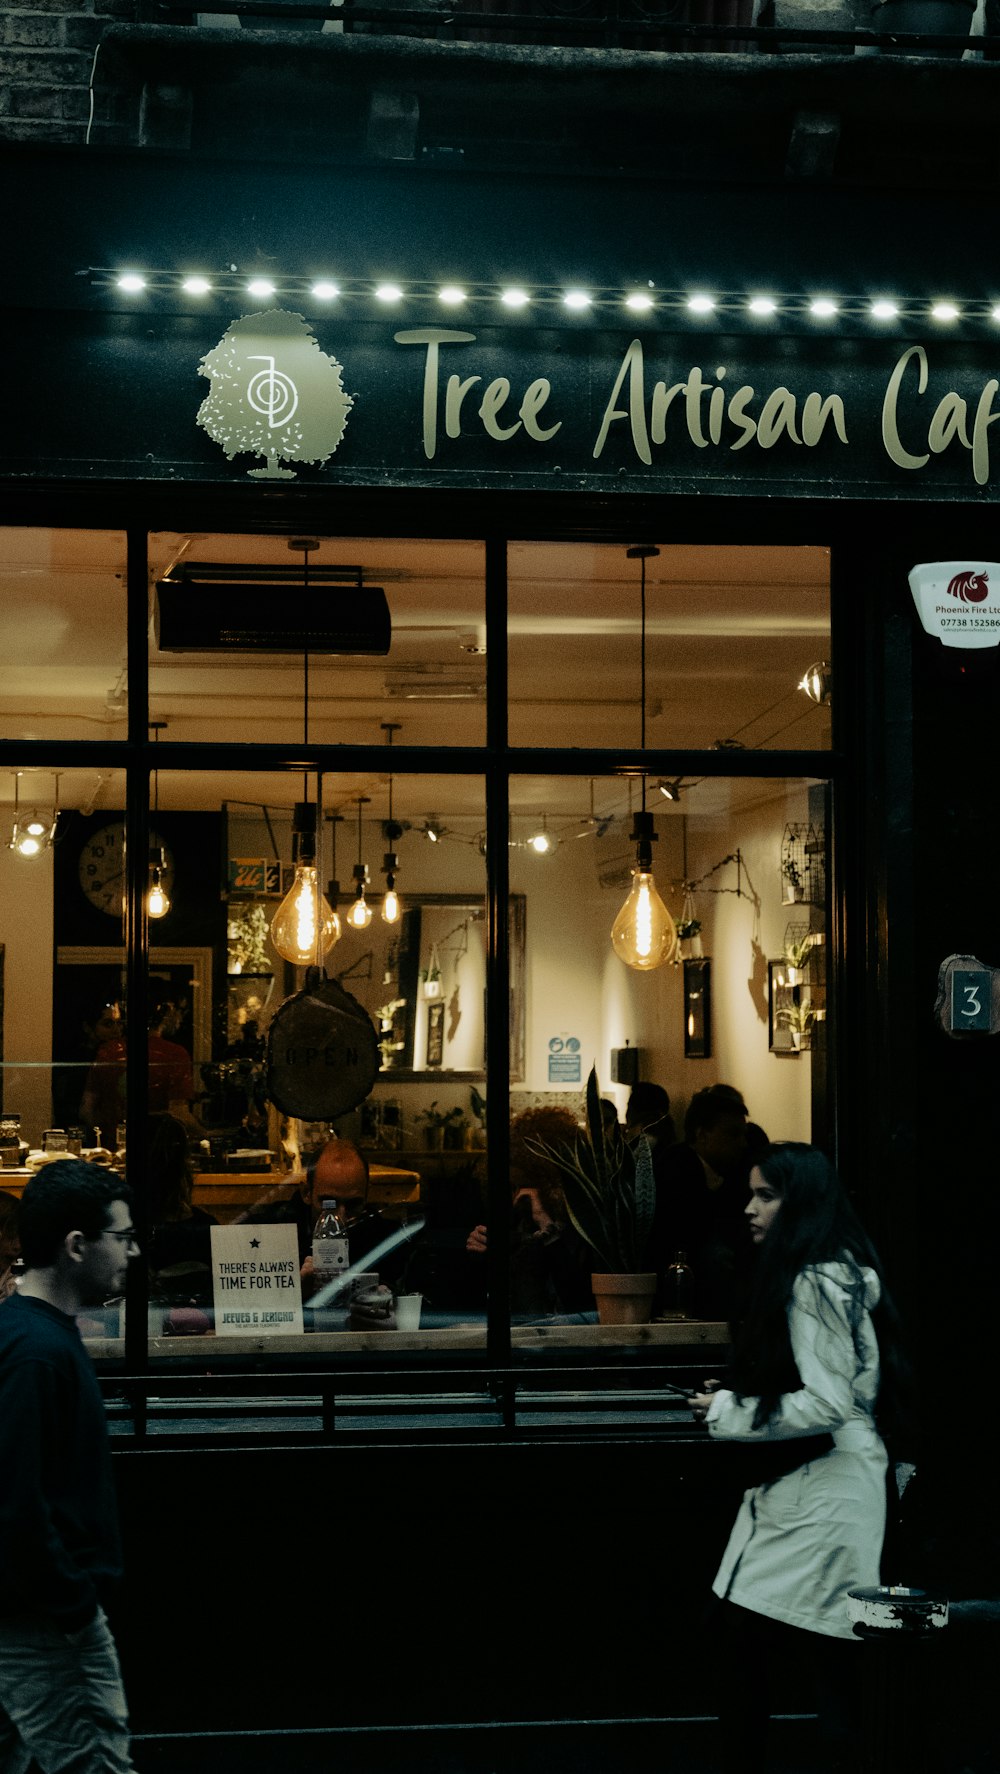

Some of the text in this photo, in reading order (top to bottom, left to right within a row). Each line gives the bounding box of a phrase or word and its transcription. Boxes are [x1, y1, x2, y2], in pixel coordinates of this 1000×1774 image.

[394, 329, 562, 459] Tree
[593, 339, 849, 466] Artisan
[936, 606, 969, 614] Phoenix
[972, 606, 987, 614] Fire
[961, 986, 981, 1016] 3
[287, 1047, 358, 1066] OPEN
[219, 1261, 294, 1274] THERE'S ALWAYS
[220, 1275, 295, 1290] TIME FOR TEA
[222, 1313, 250, 1323] JEEVES
